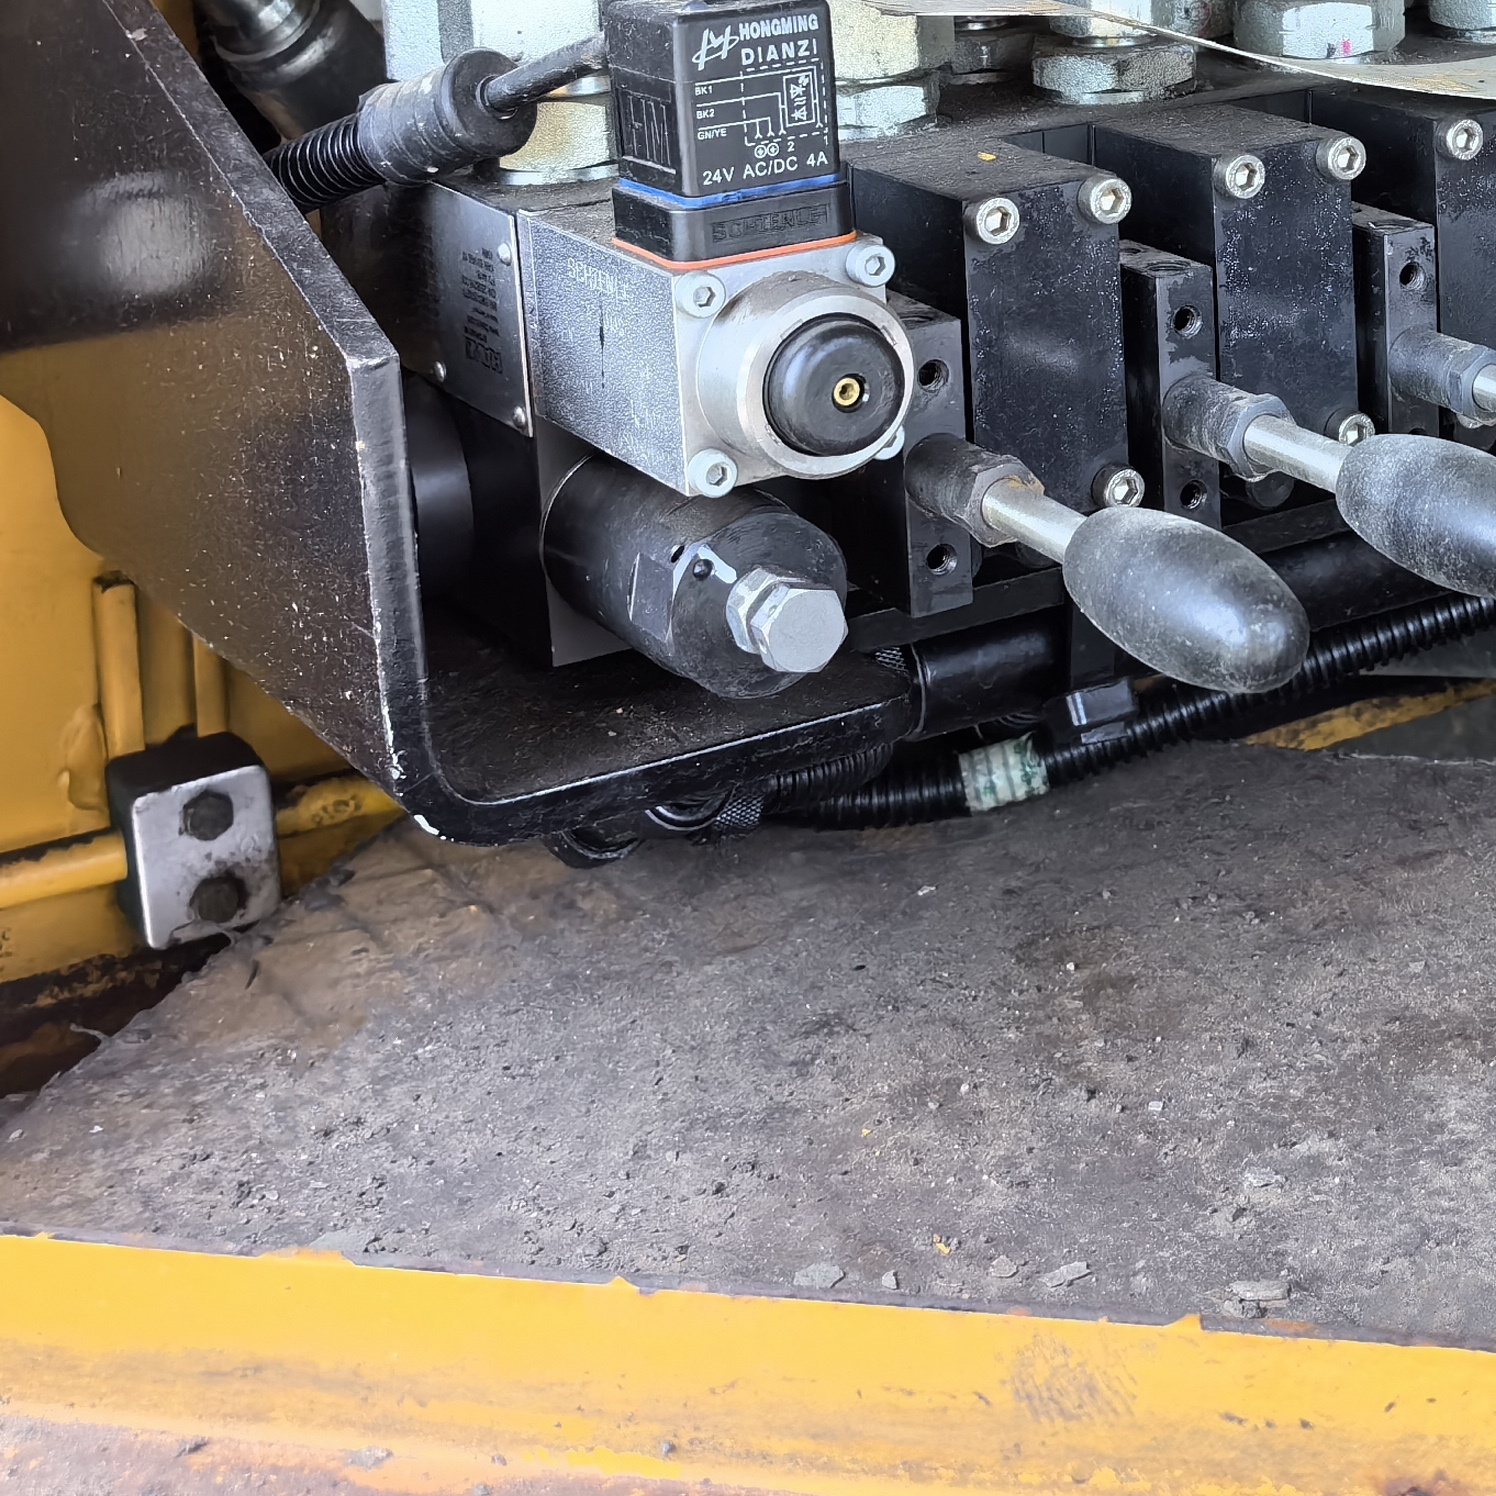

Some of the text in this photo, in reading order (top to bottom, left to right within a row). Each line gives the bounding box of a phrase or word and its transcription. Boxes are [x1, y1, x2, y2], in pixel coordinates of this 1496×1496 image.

[738, 13, 818, 41] HONGMING
[741, 38, 818, 66] DIANZI
[694, 85, 713, 96] BK1
[696, 109, 715, 120] BK2
[697, 128, 728, 140] GN/YE
[787, 141, 795, 152] 2
[702, 151, 829, 186] 24V AC/DC 4A
